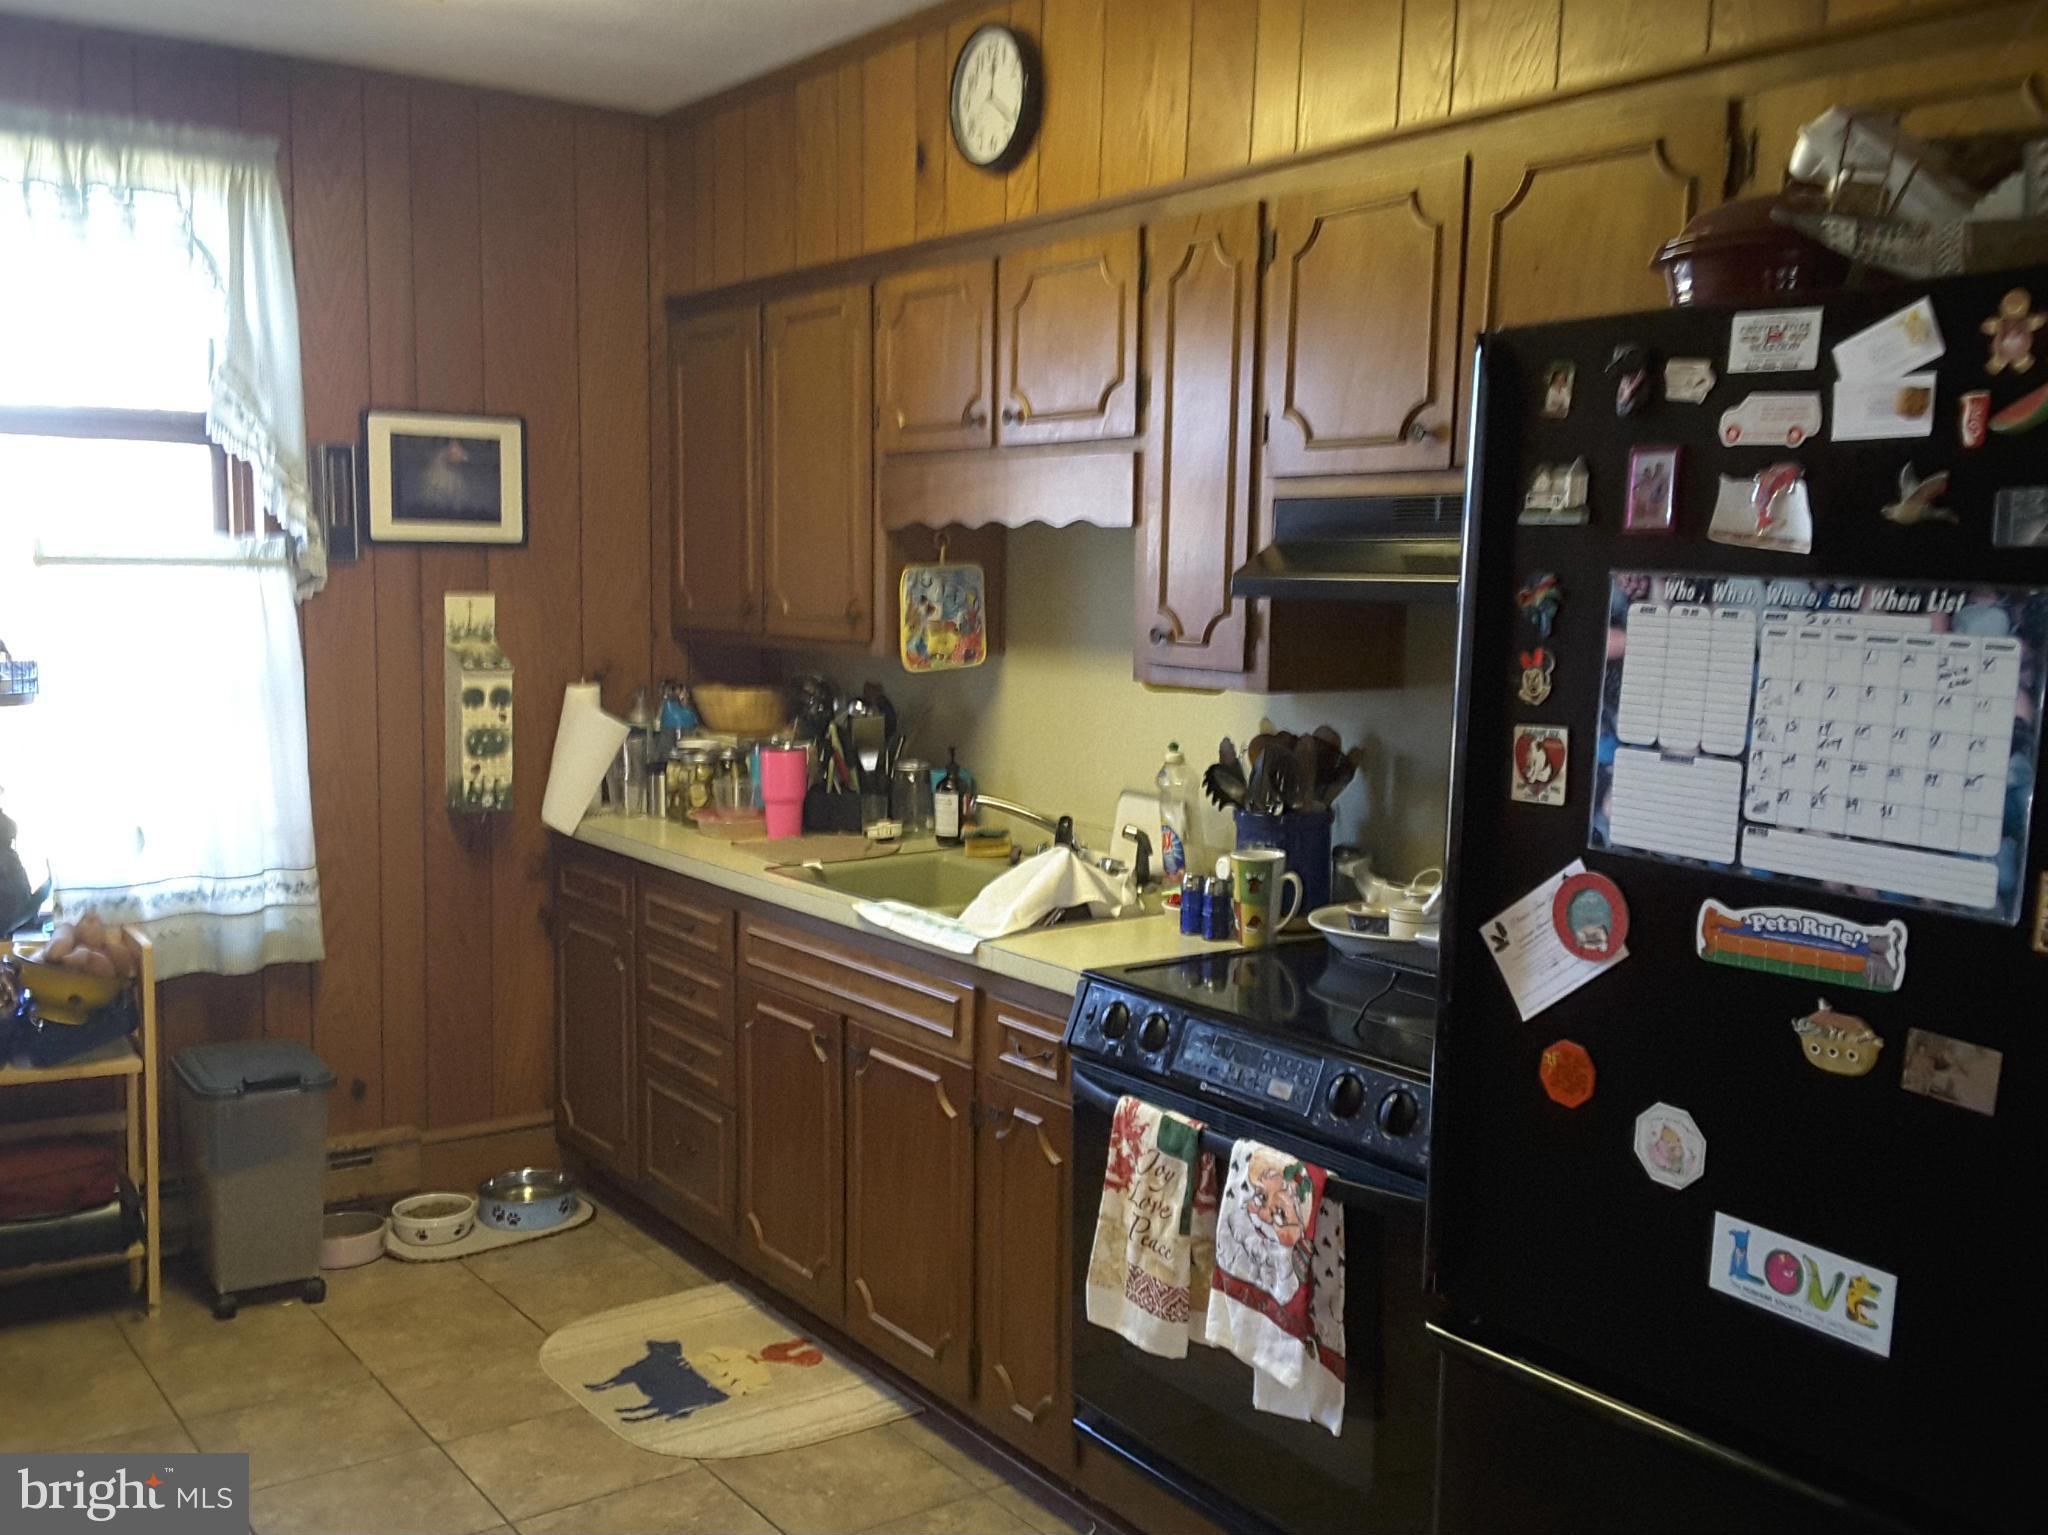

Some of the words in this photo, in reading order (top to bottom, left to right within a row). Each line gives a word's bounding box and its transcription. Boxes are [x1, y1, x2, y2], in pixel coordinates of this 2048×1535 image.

[1765, 584, 1822, 609] Where,
[1828, 585, 1865, 609] and
[1869, 585, 1920, 612] When
[1927, 587, 1966, 613] List
[1749, 912, 1797, 932] Pets
[1800, 916, 1864, 949] Rule!
[1137, 1150, 1176, 1194] Joy
[1127, 1180, 1172, 1218] Love
[1128, 1214, 1172, 1260] Peace
[1728, 1230, 1882, 1330] LOVE
